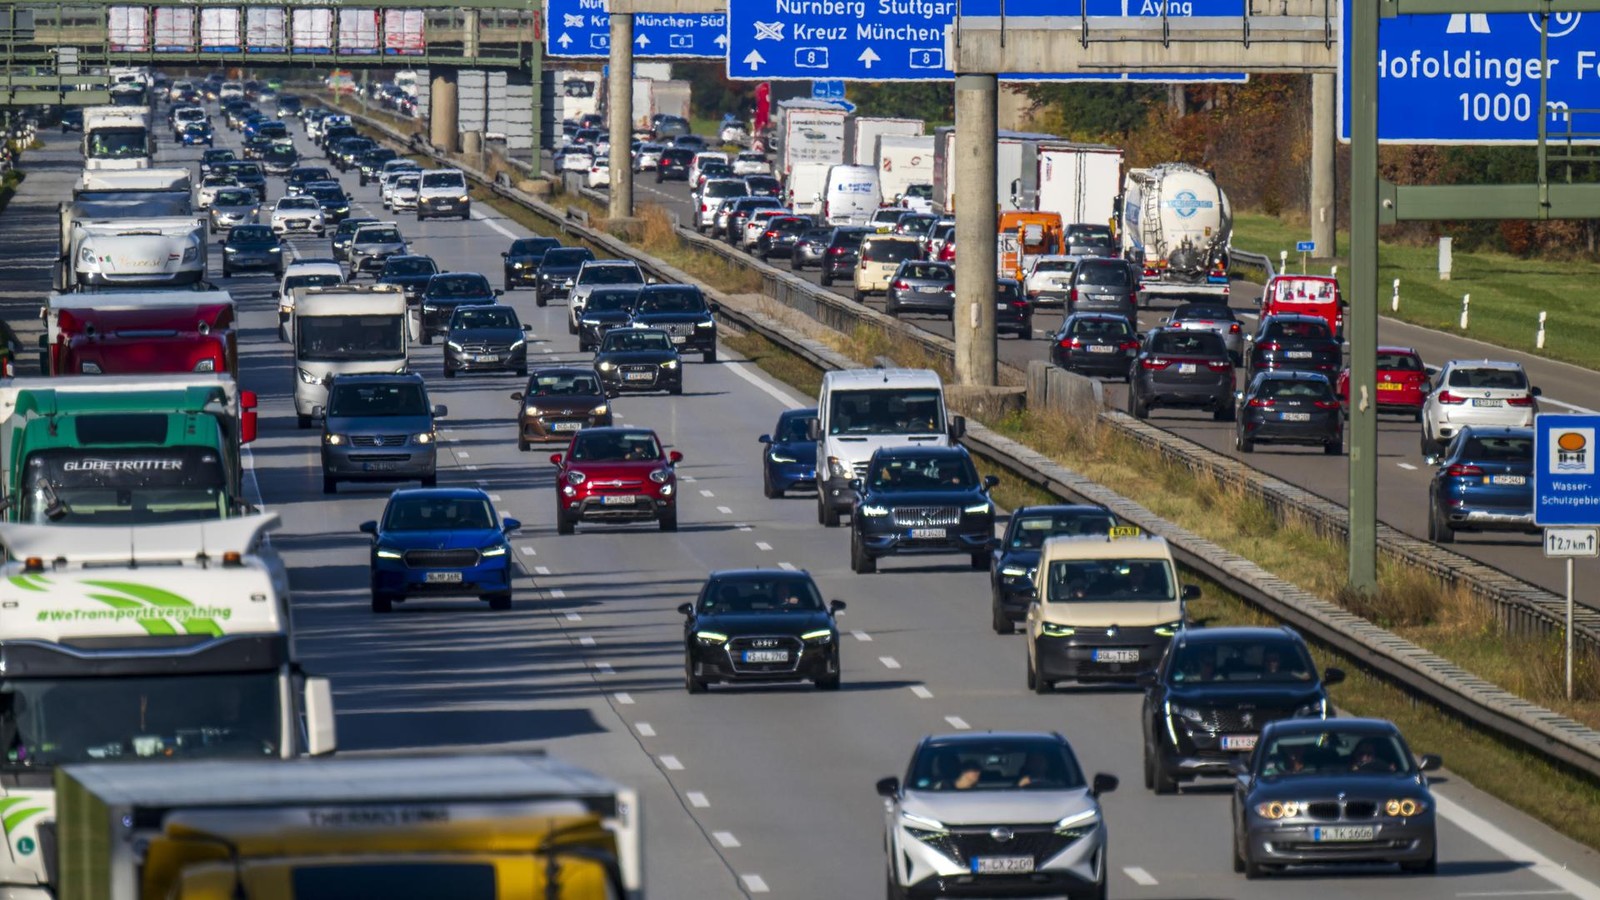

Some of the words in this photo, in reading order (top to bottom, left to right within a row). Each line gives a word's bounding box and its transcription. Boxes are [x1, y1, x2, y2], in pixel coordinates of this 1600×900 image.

[1140, 0, 1193, 16] Aying
[635, 15, 725, 28] München-Süd
[793, 24, 847, 40] Kreuz
[856, 24, 945, 41] München-
[807, 52, 815, 63] 8
[923, 53, 930, 64] 8
[1459, 92, 1531, 121] 1000
[1547, 101, 1569, 121] m
[63, 460, 183, 471] GLOBETROTTER
[1552, 481, 1592, 491] Wasser-
[1117, 527, 1137, 536] TAXI
[1557, 537, 1571, 550] 2,7
[1573, 541, 1586, 550] km
[36, 607, 232, 623] #WeTransportEverything
[1116, 651, 1127, 660] TT
[21, 840, 31, 852] L
